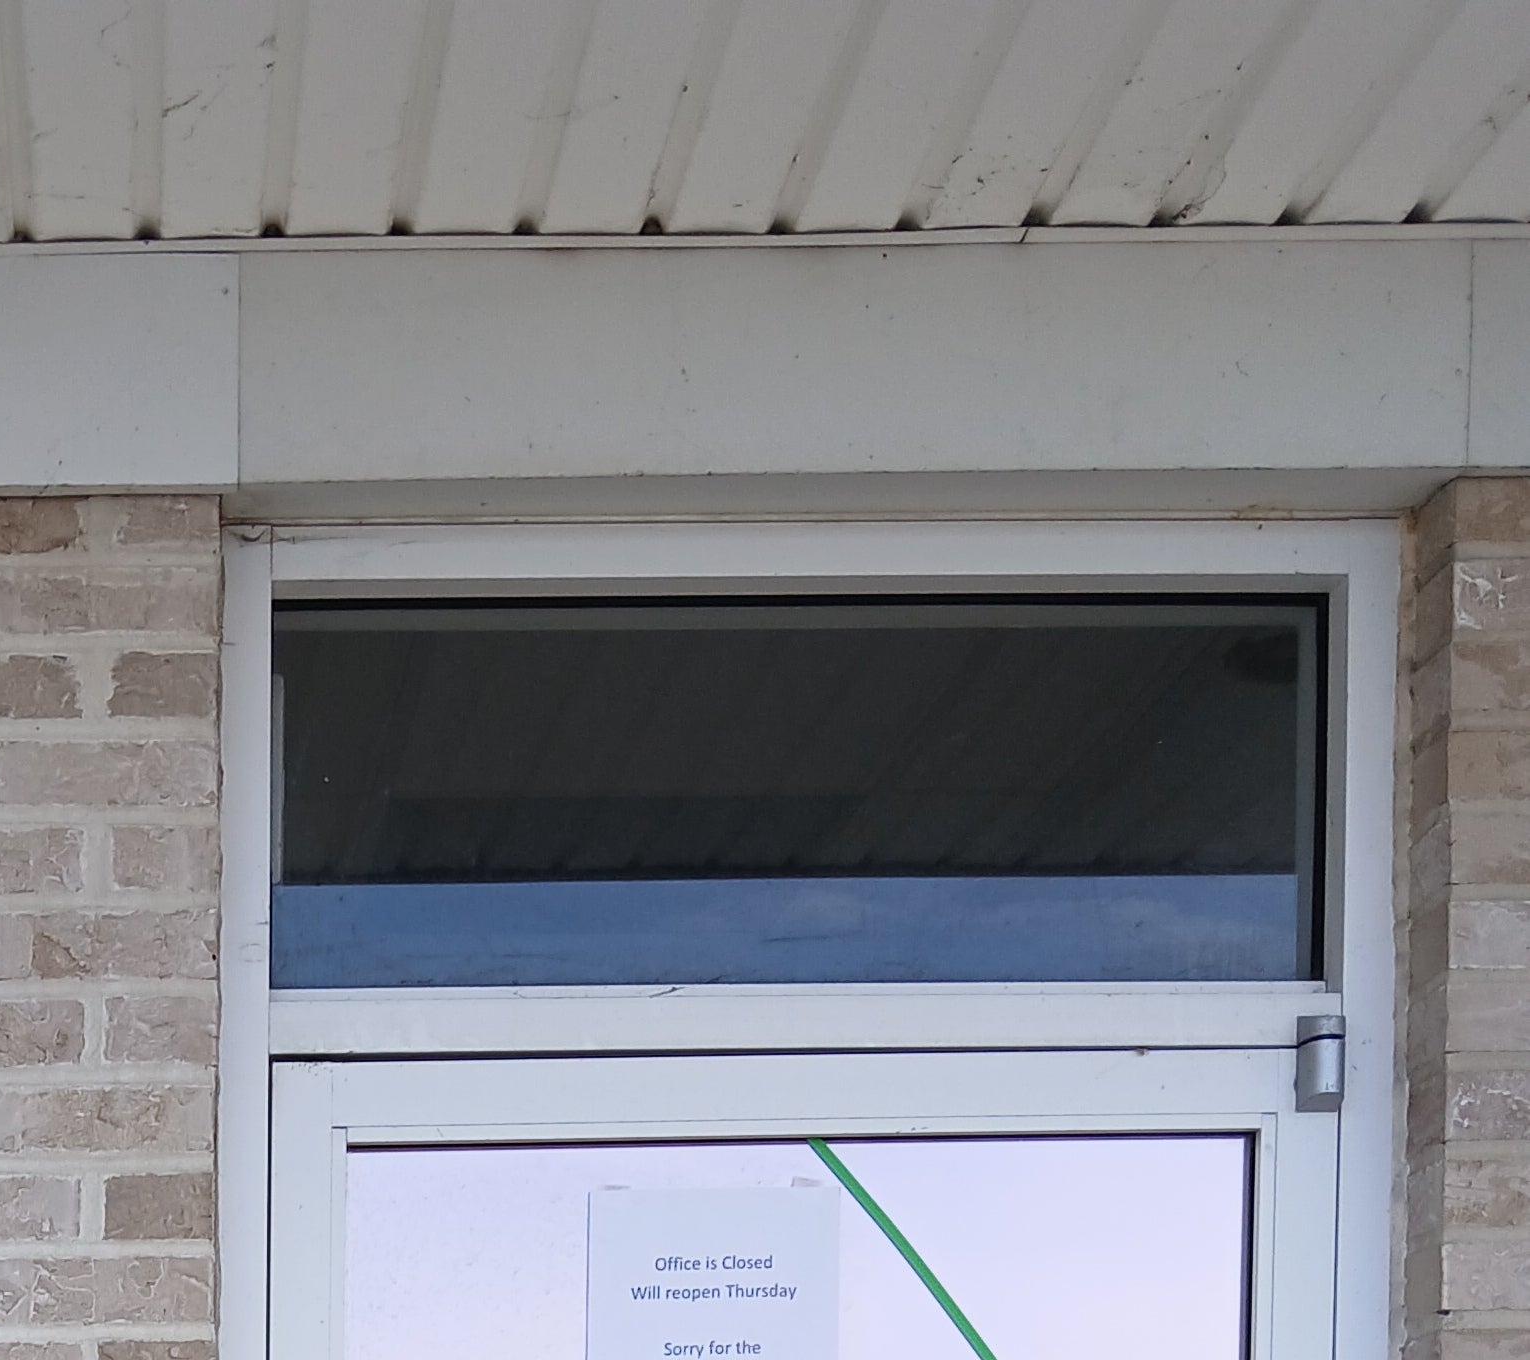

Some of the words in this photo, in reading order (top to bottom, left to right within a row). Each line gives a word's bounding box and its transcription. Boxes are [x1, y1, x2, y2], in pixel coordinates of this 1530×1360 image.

[655, 1256, 701, 1271] Office
[706, 1256, 717, 1271] is
[722, 1255, 773, 1270] Closed
[631, 1285, 661, 1300] Will
[666, 1287, 720, 1302] reopen
[726, 1283, 797, 1300] Thursday
[664, 1342, 704, 1359] Sorry
[709, 1341, 732, 1355] for
[736, 1340, 762, 1355] the
